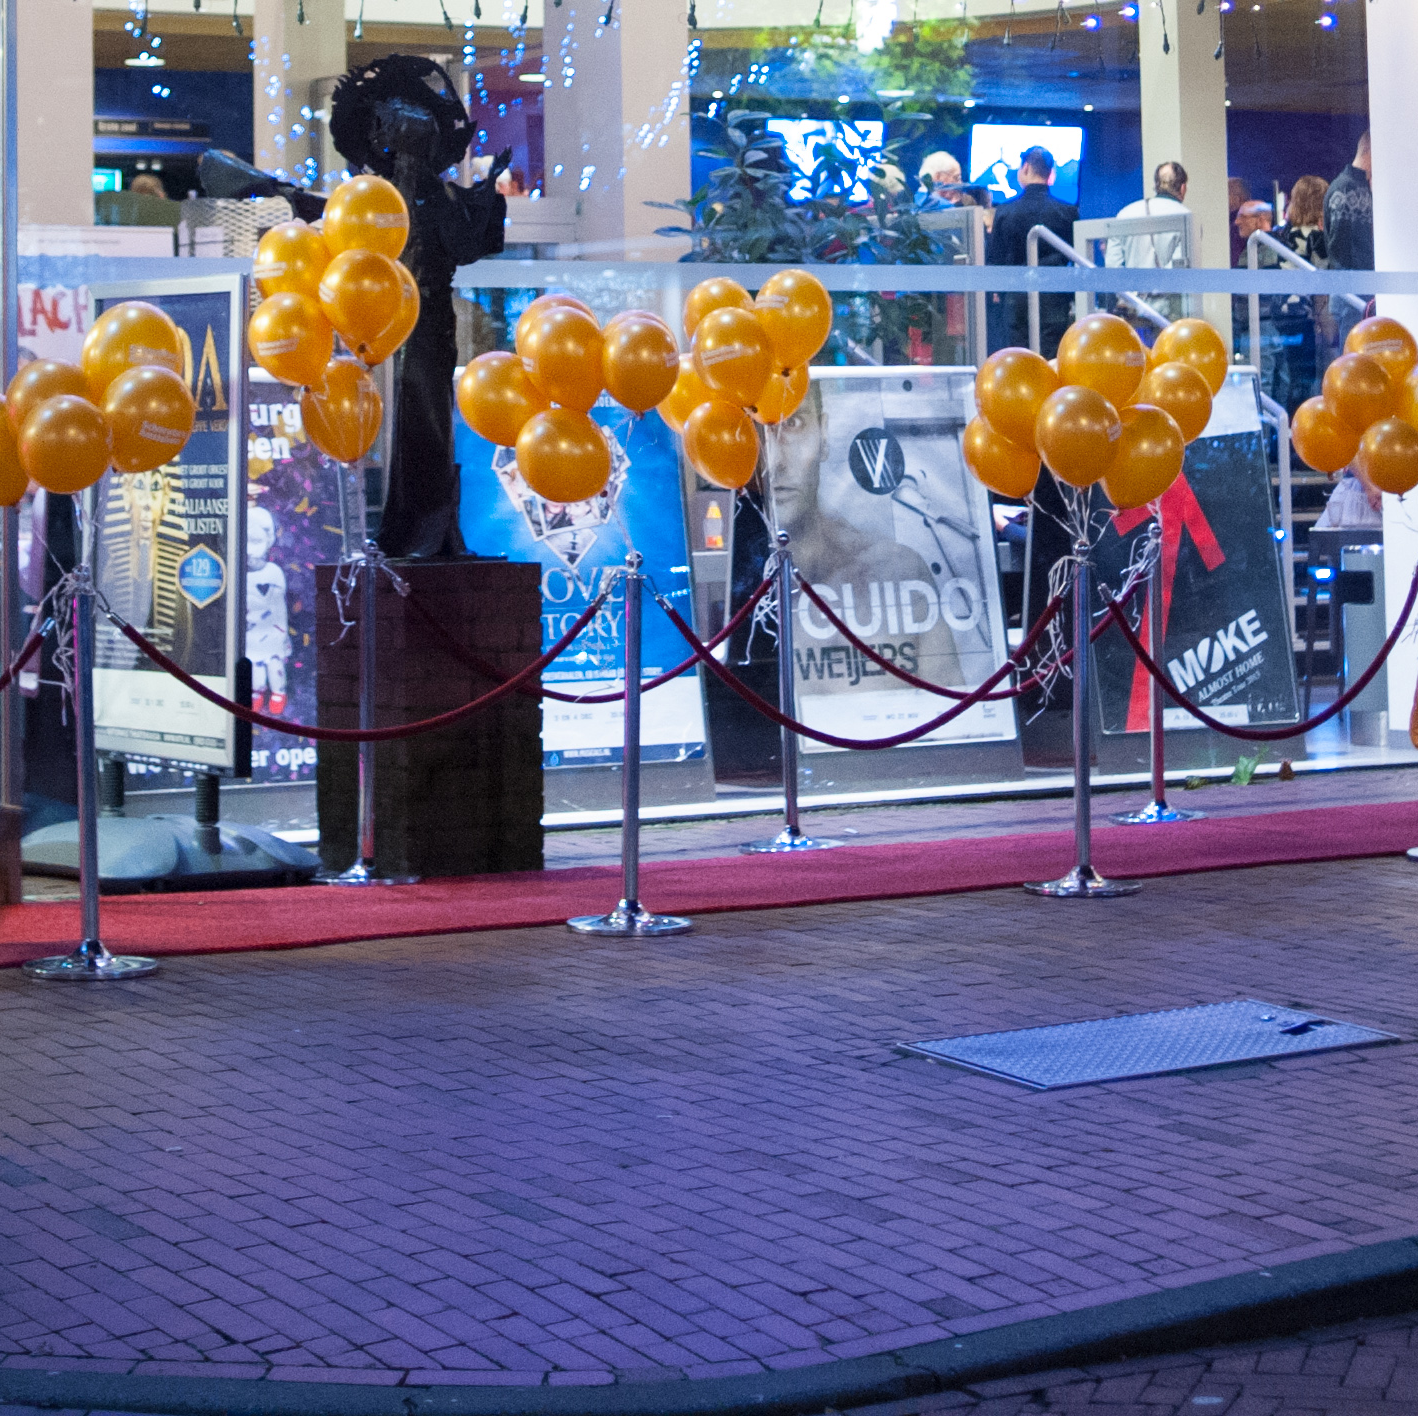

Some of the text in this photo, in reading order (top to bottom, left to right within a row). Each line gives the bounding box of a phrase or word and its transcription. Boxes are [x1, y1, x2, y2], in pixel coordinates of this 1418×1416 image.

[248, 403, 303, 433] urg
[542, 566, 623, 603] OVE
[798, 578, 980, 639] GUIDO
[1198, 650, 1265, 703] ALMOST HOME
